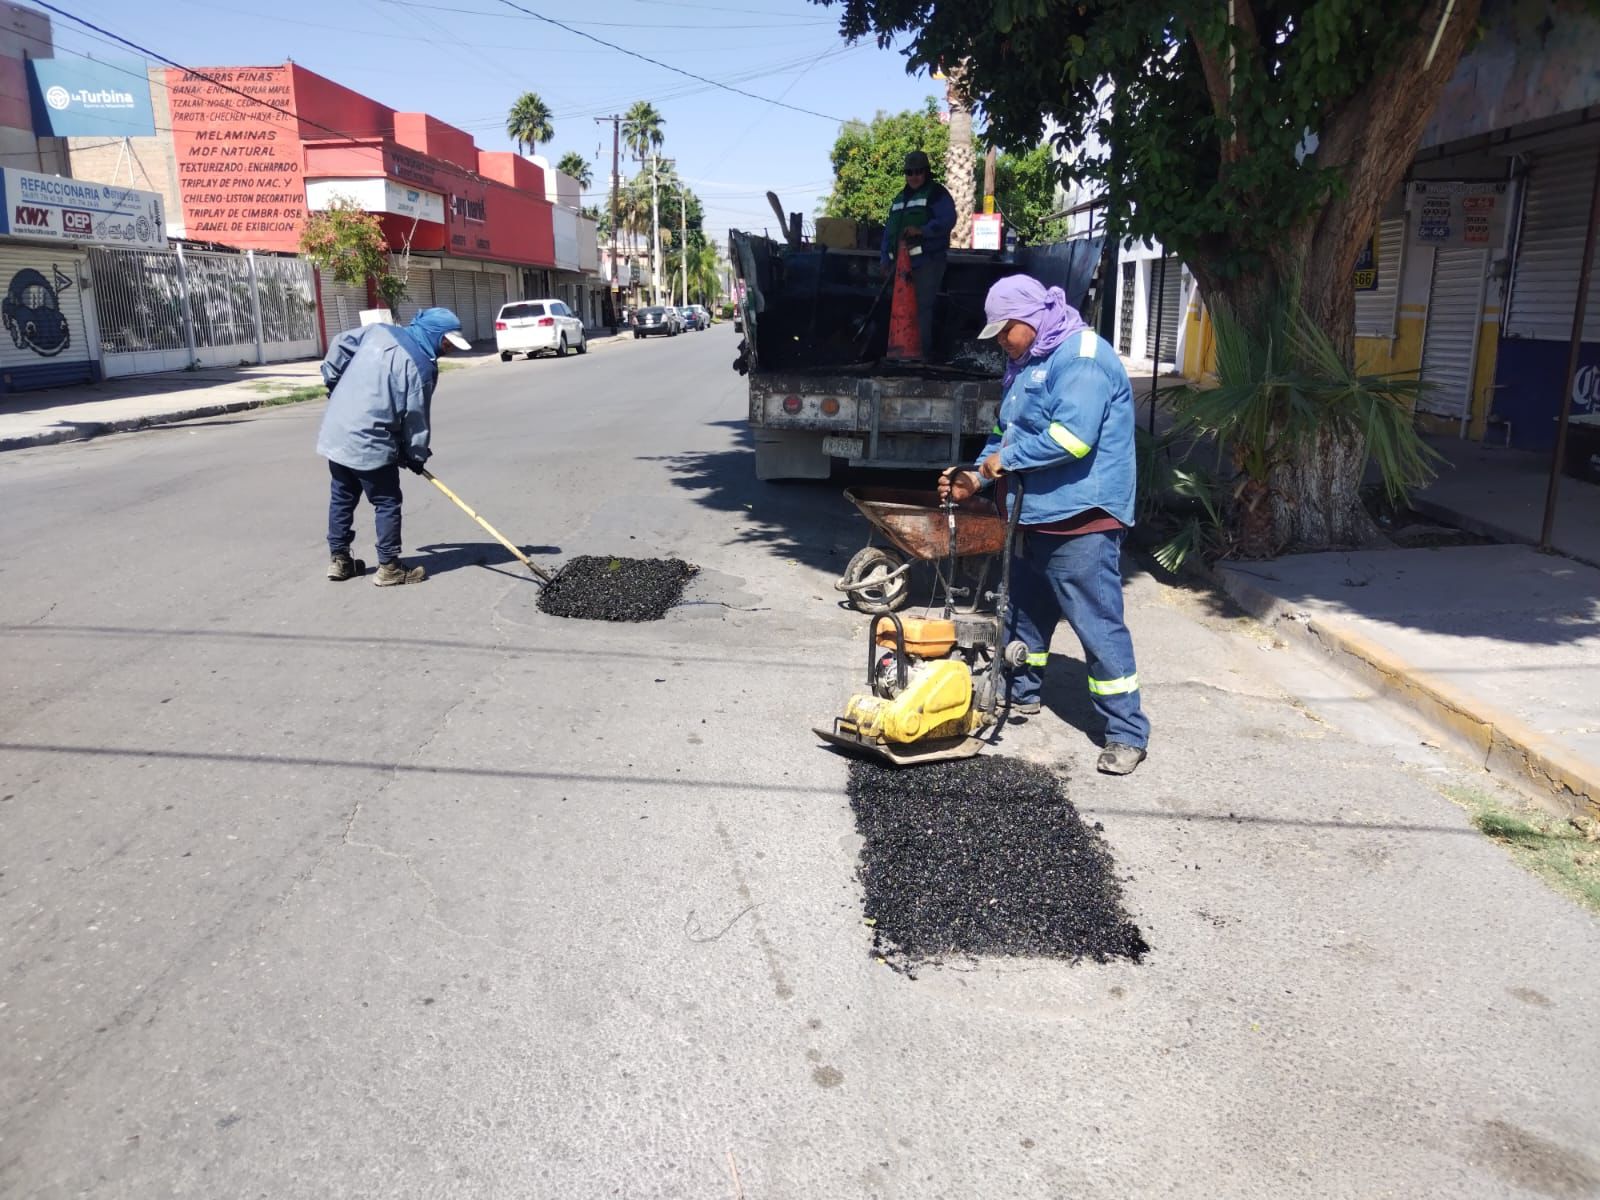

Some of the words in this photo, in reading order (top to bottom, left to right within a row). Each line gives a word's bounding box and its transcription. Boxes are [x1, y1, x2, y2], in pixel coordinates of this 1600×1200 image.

[183, 73, 233, 82] MADERAS
[268, 86, 290, 94] MAPLE
[79, 90, 133, 103] Turbina
[195, 130, 277, 140] MELAMINAS
[188, 147, 218, 156] MDF
[220, 147, 275, 156] NATURAL
[181, 179, 217, 188] TRIPLAY
[219, 179, 231, 188] DE
[232, 179, 254, 188] PINO
[256, 178, 281, 188] NAC.
[283, 178, 292, 187] Y
[20, 176, 100, 200] REFACCIONARIA
[256, 194, 304, 203] DECORATIVO
[16, 205, 49, 227] KWX
[188, 209, 225, 218] TRIPLAY
[228, 209, 239, 218] DE
[65, 212, 90, 229] OEP
[195, 222, 228, 231] PANEL
[231, 222, 243, 231] DE
[246, 222, 295, 231] EXIBICION
